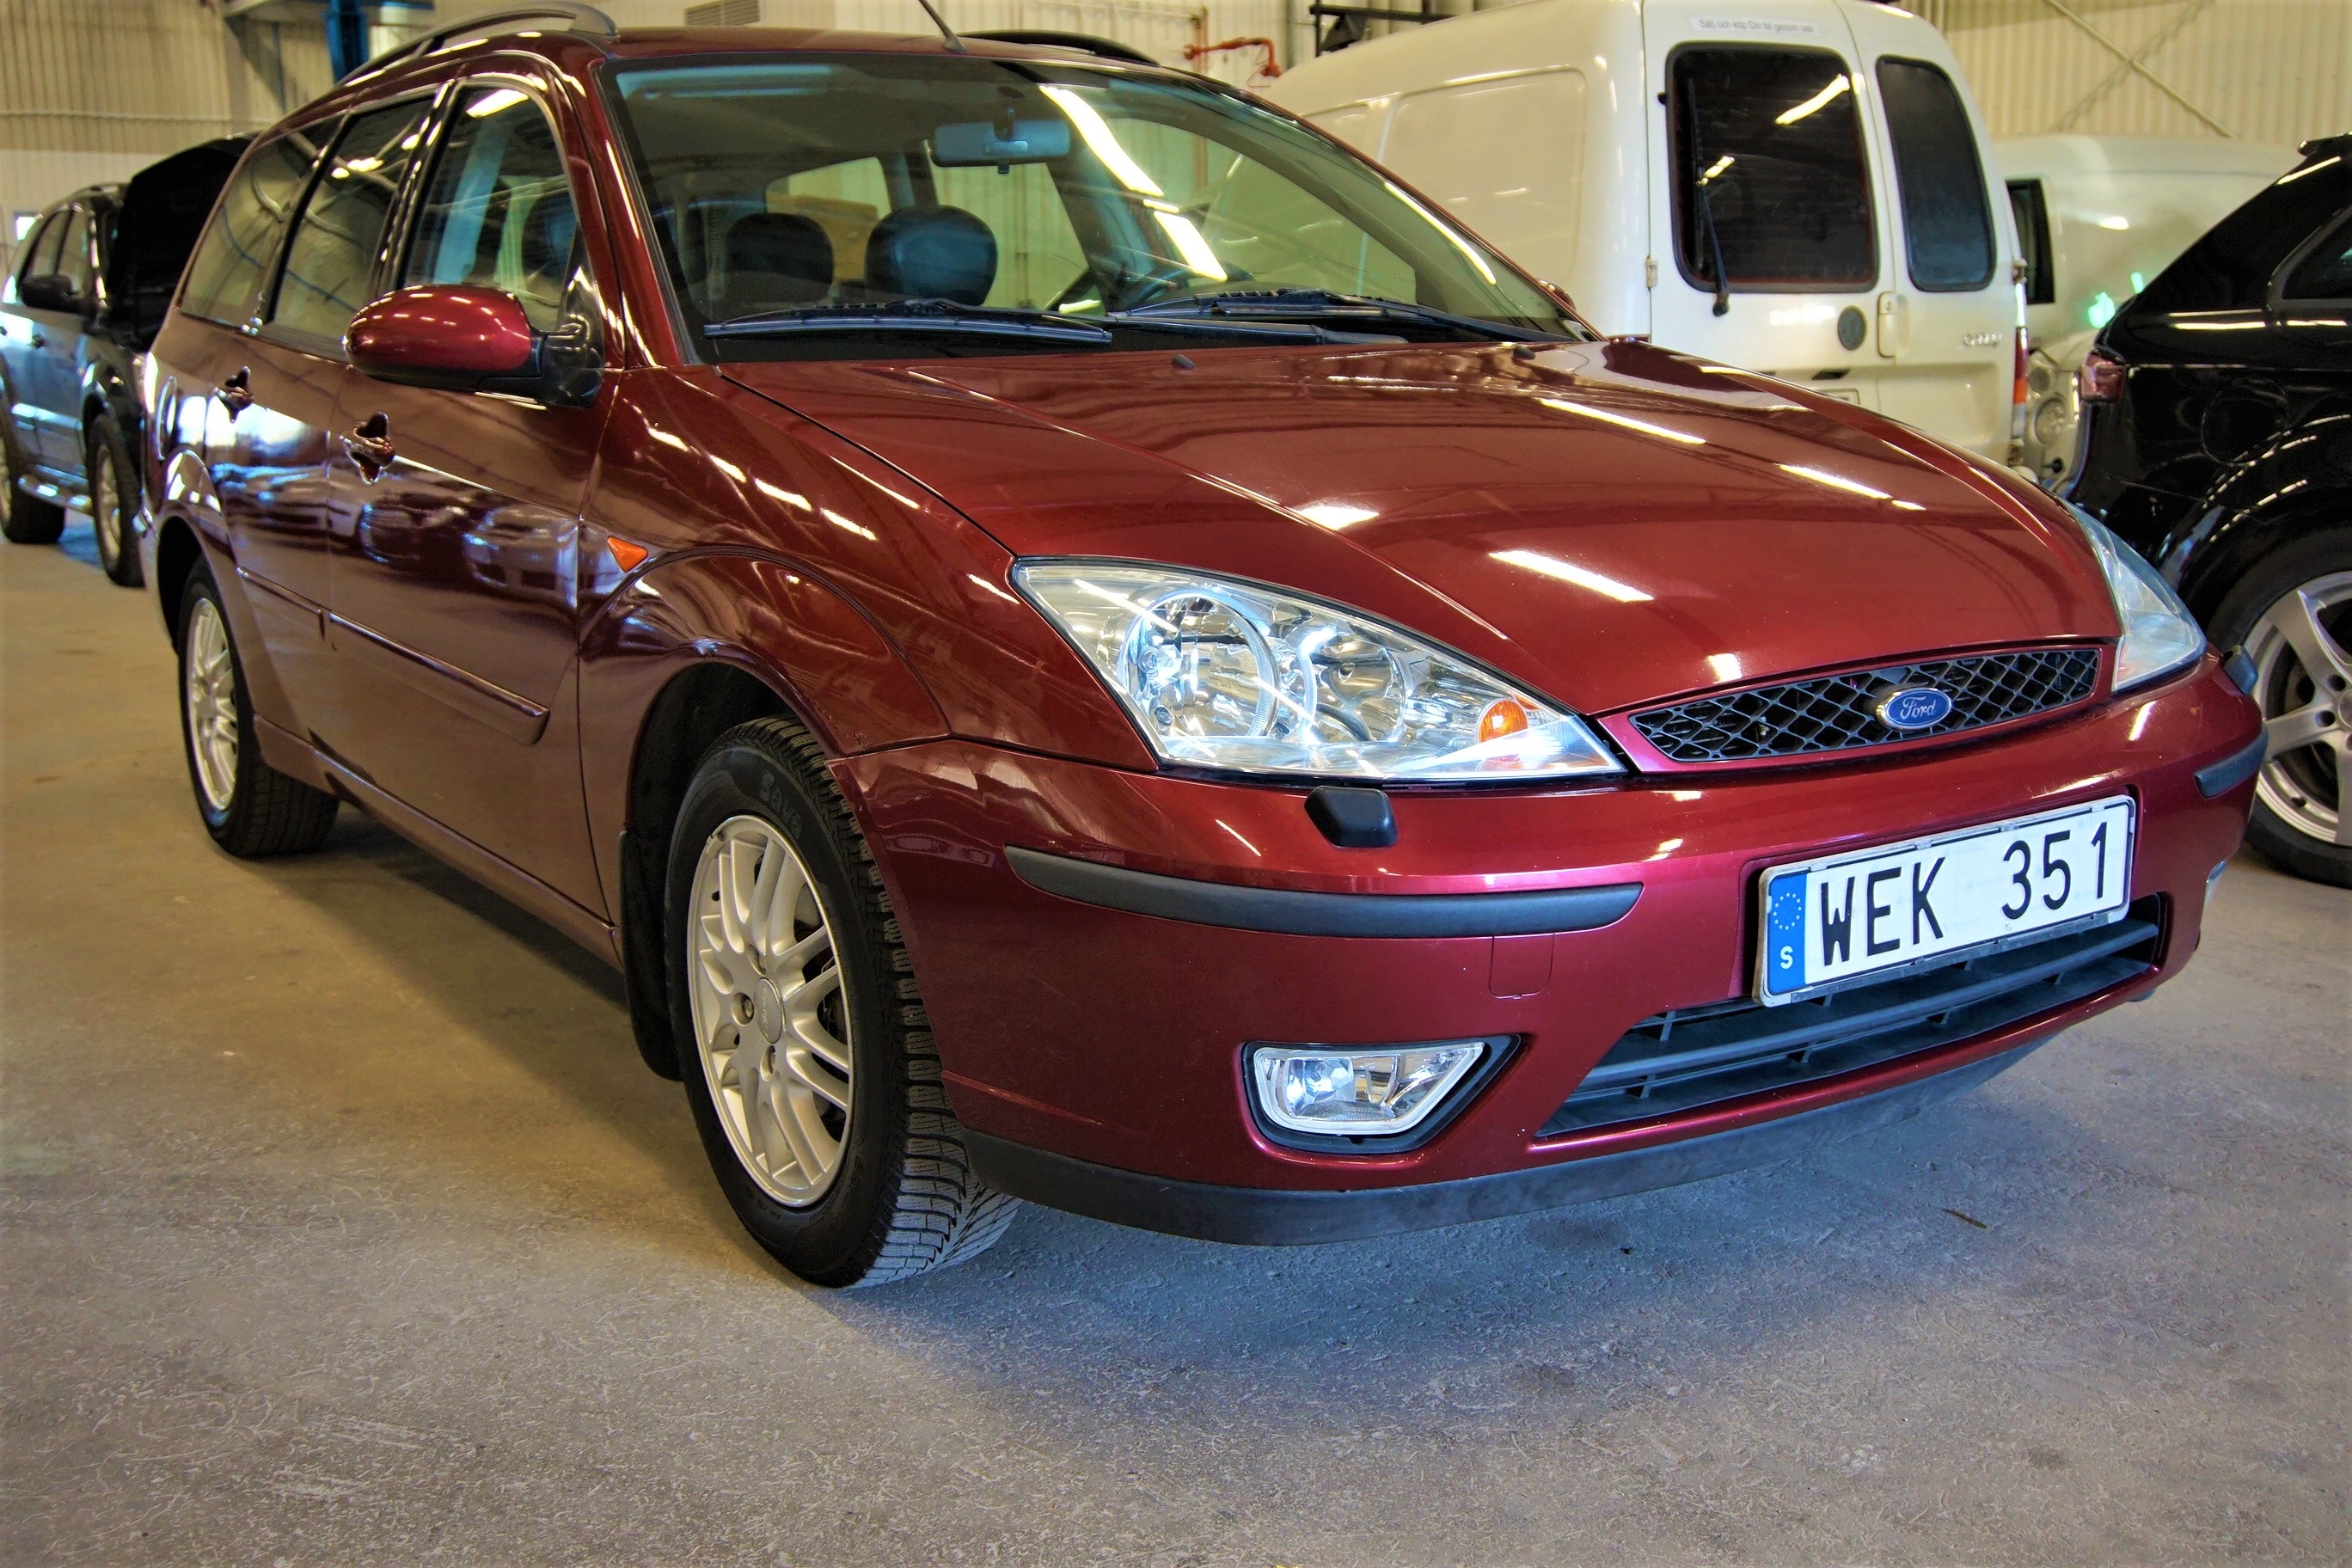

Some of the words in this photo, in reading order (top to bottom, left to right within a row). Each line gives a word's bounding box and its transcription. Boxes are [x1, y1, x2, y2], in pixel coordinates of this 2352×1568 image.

[1900, 695, 1937, 720] Ford
[1820, 856, 1945, 967] WEK
[2001, 821, 2108, 920] 351
[1779, 945, 1794, 971] S
